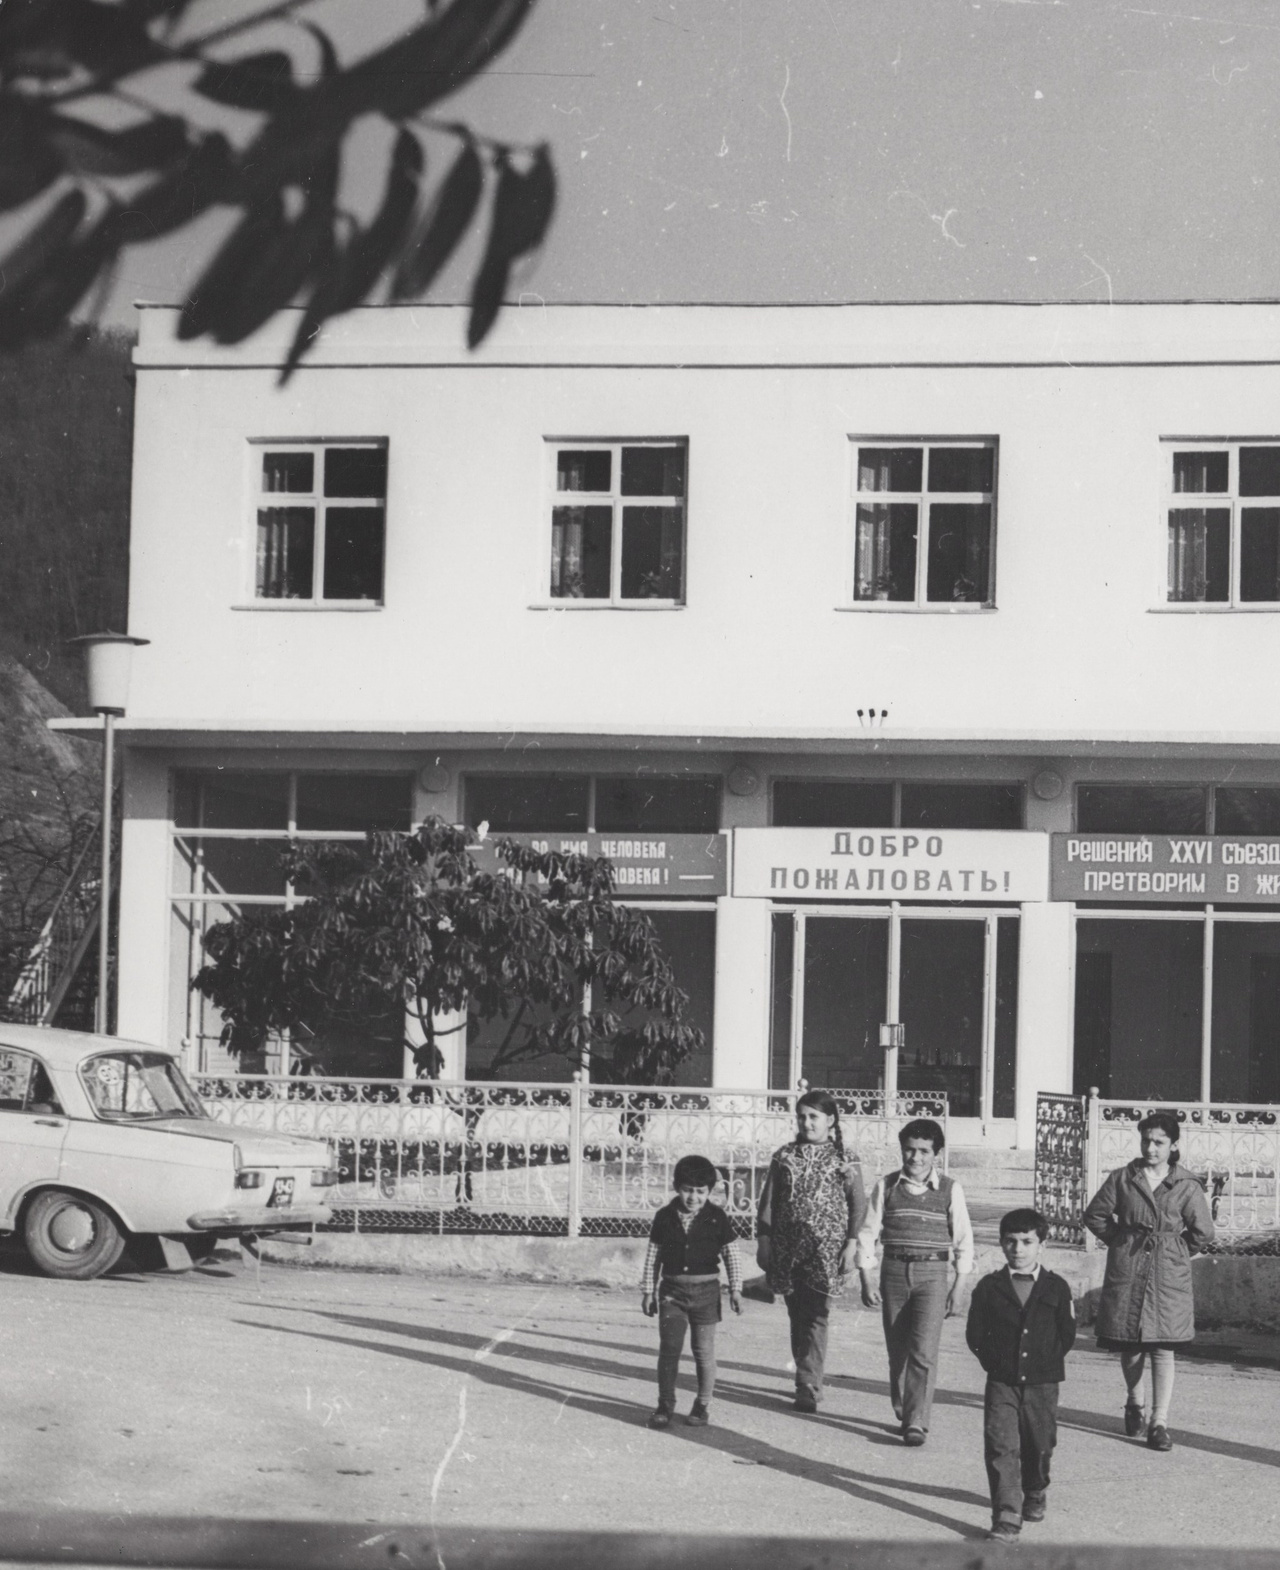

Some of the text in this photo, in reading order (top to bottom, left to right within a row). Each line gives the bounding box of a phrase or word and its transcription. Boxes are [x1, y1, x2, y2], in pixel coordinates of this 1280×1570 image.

[601, 840, 674, 860] ЧЕЛОВЕКА,
[830, 832, 943, 857] ДОБРО
[1169, 841, 1213, 864] XXVI
[770, 867, 1011, 893] ПОЖАЛОВАТЬ!
